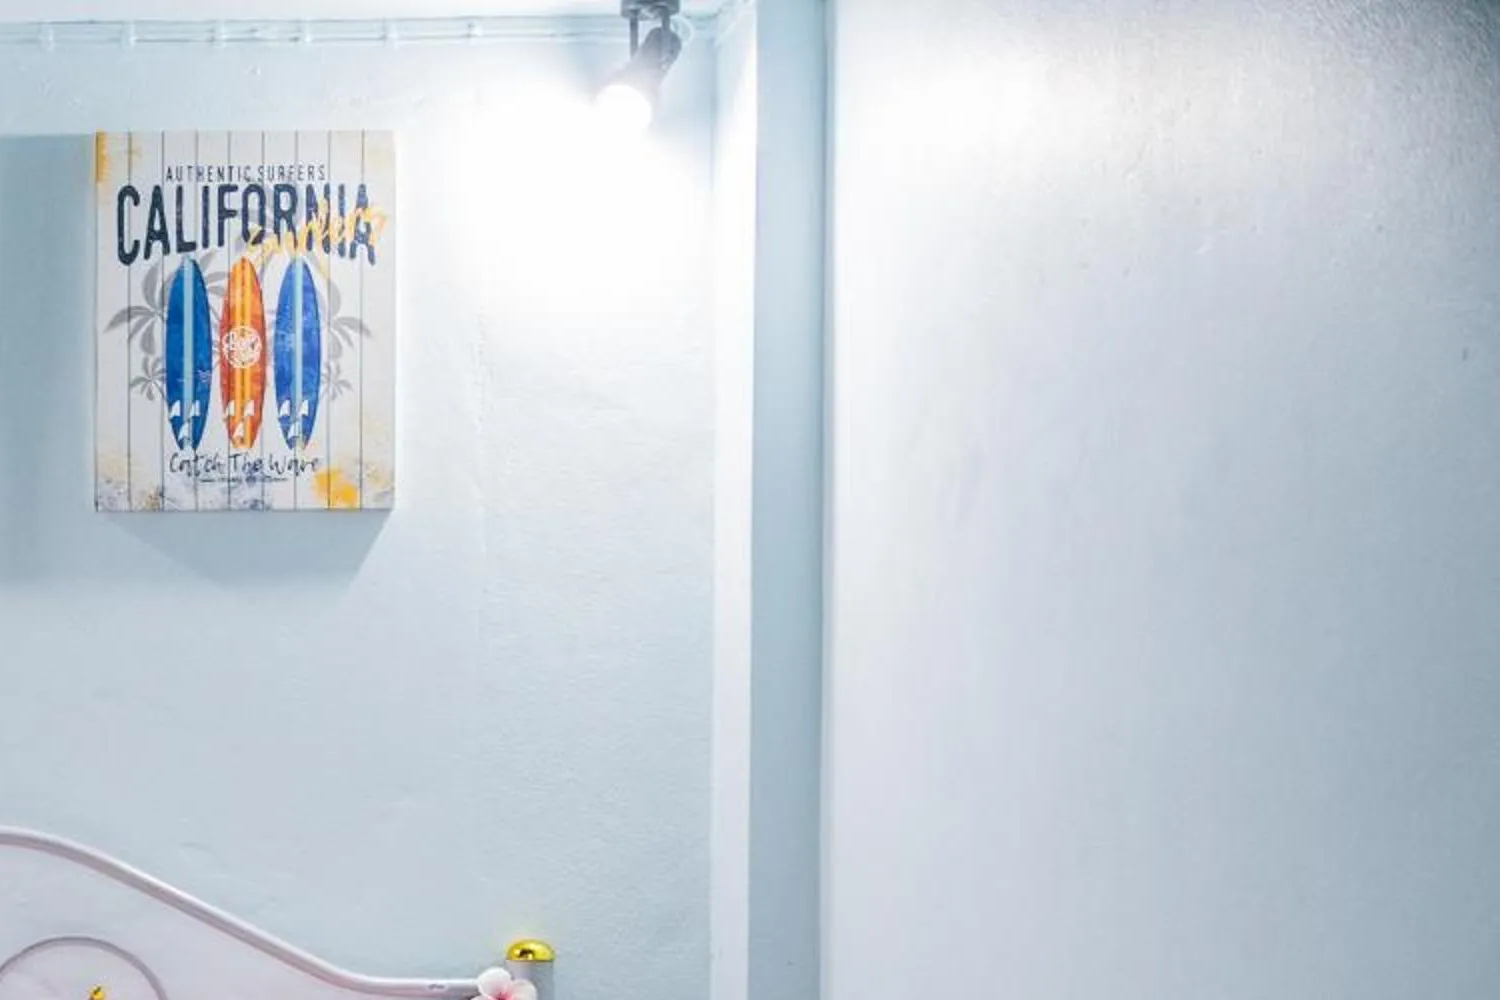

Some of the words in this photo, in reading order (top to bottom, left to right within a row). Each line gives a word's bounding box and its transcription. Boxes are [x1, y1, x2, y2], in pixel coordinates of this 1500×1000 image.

[165, 165, 252, 183] AUTHENTIC
[257, 164, 326, 182] SURFERS
[116, 183, 376, 266] CALIFORNIA
[228, 452, 263, 473] The
